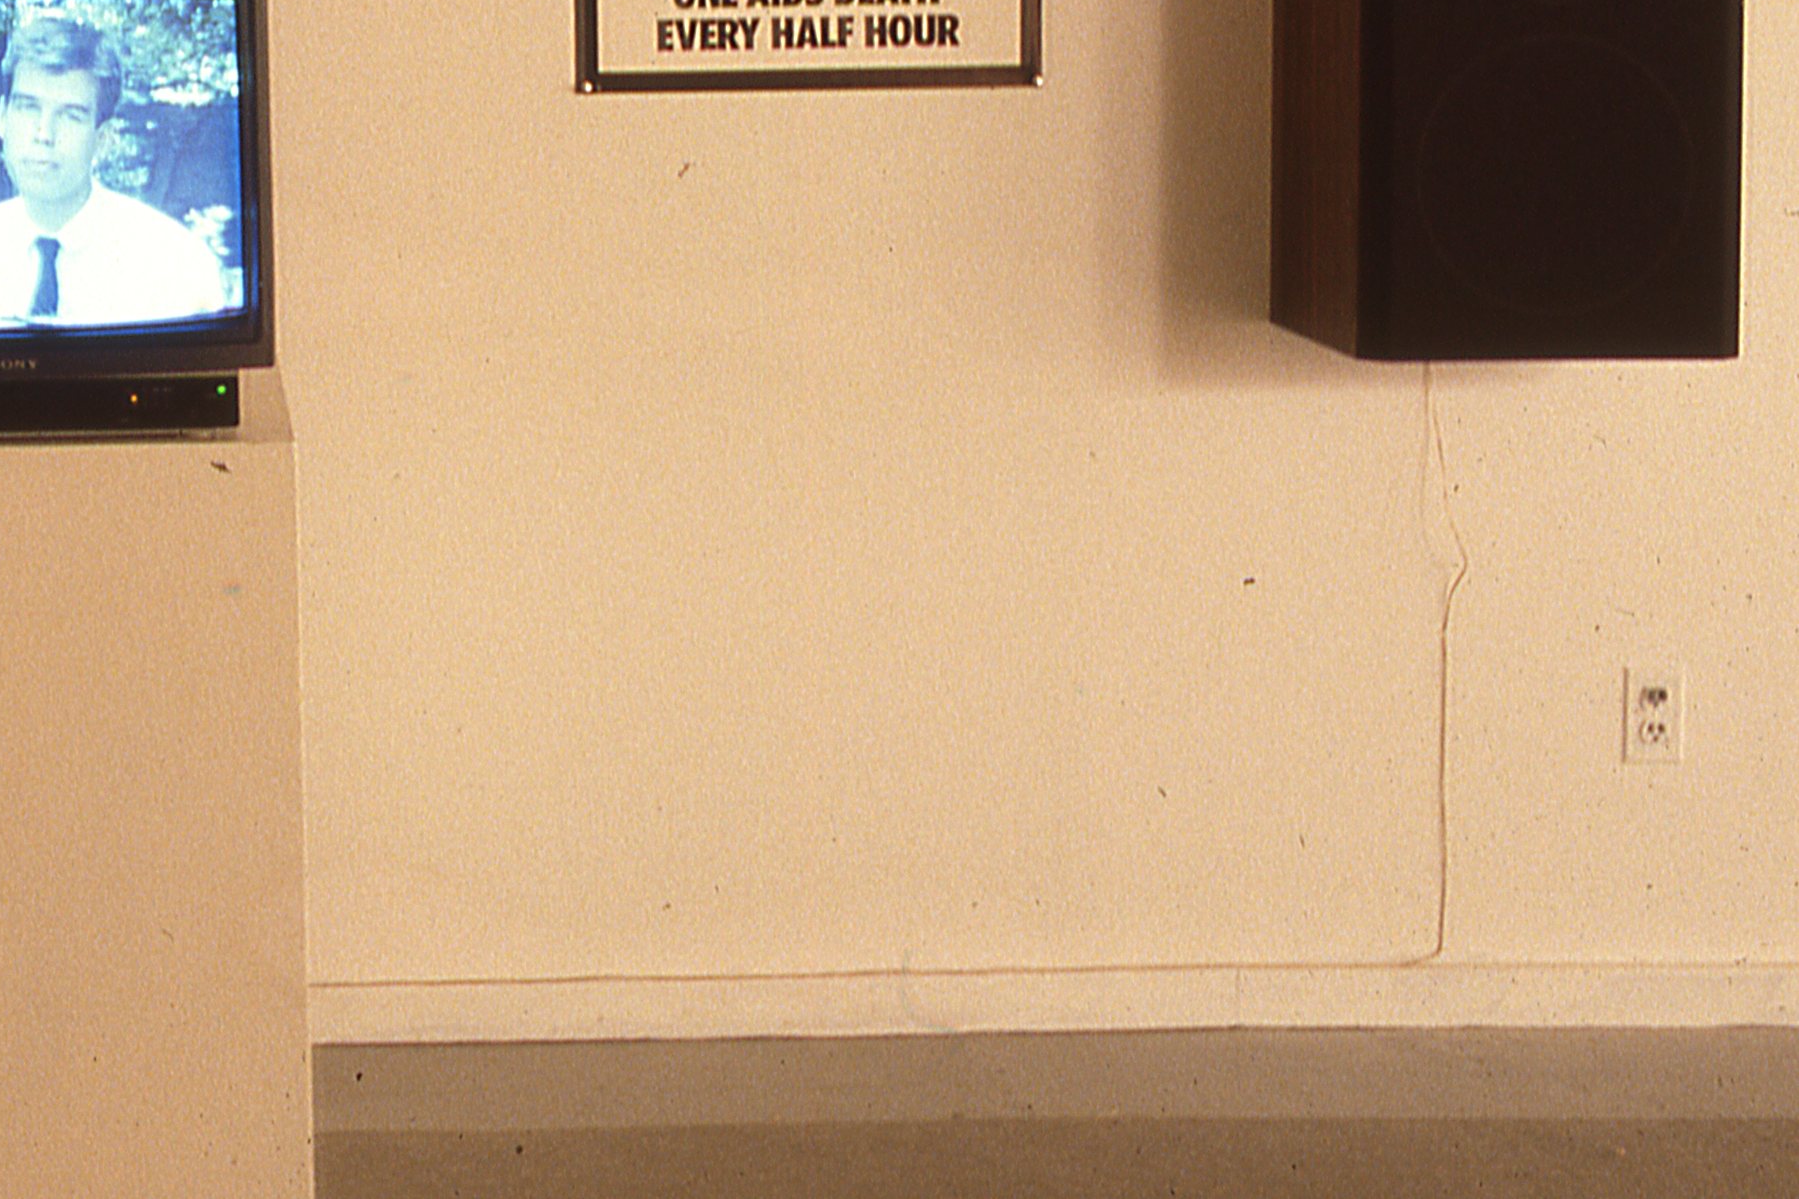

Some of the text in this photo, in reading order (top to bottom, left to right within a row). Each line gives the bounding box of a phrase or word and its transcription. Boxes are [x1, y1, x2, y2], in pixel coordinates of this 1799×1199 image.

[657, 13, 960, 52] EVERY HALF HOUR
